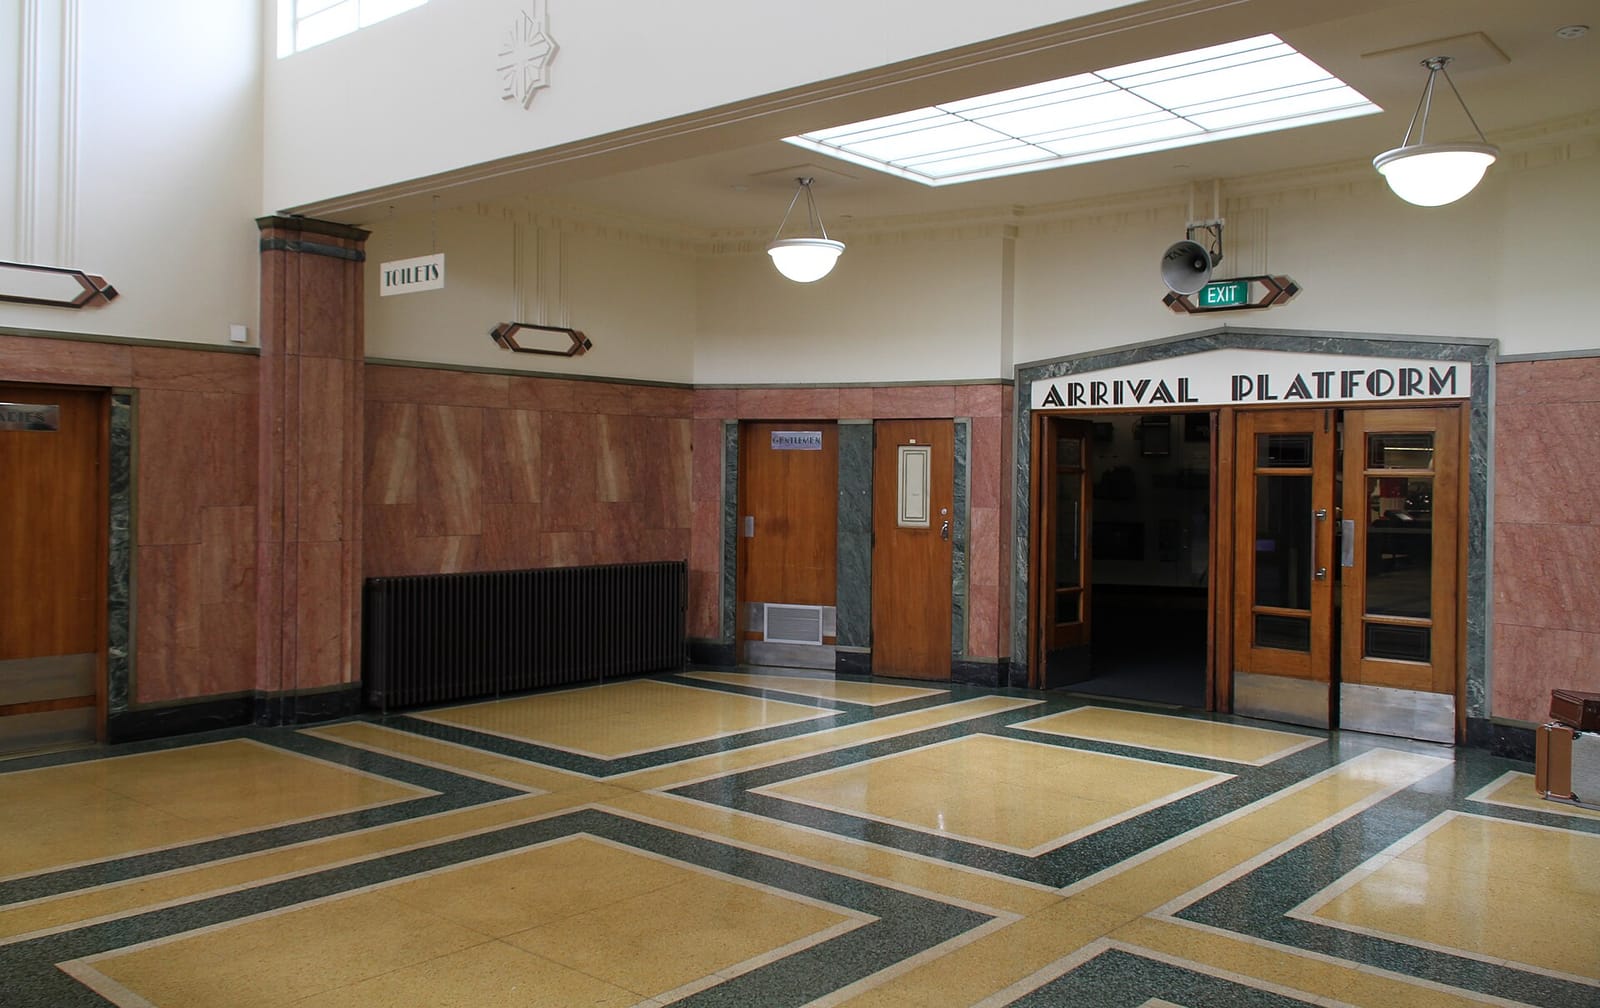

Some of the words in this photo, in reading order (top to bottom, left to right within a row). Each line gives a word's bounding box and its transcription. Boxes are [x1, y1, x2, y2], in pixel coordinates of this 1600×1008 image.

[384, 263, 439, 287] TOILETS
[1207, 285, 1237, 303] EXIT
[1042, 377, 1198, 407] ARRIVAL
[1231, 365, 1457, 401] PLATFORM
[772, 435, 821, 445] GENTLEMEN
